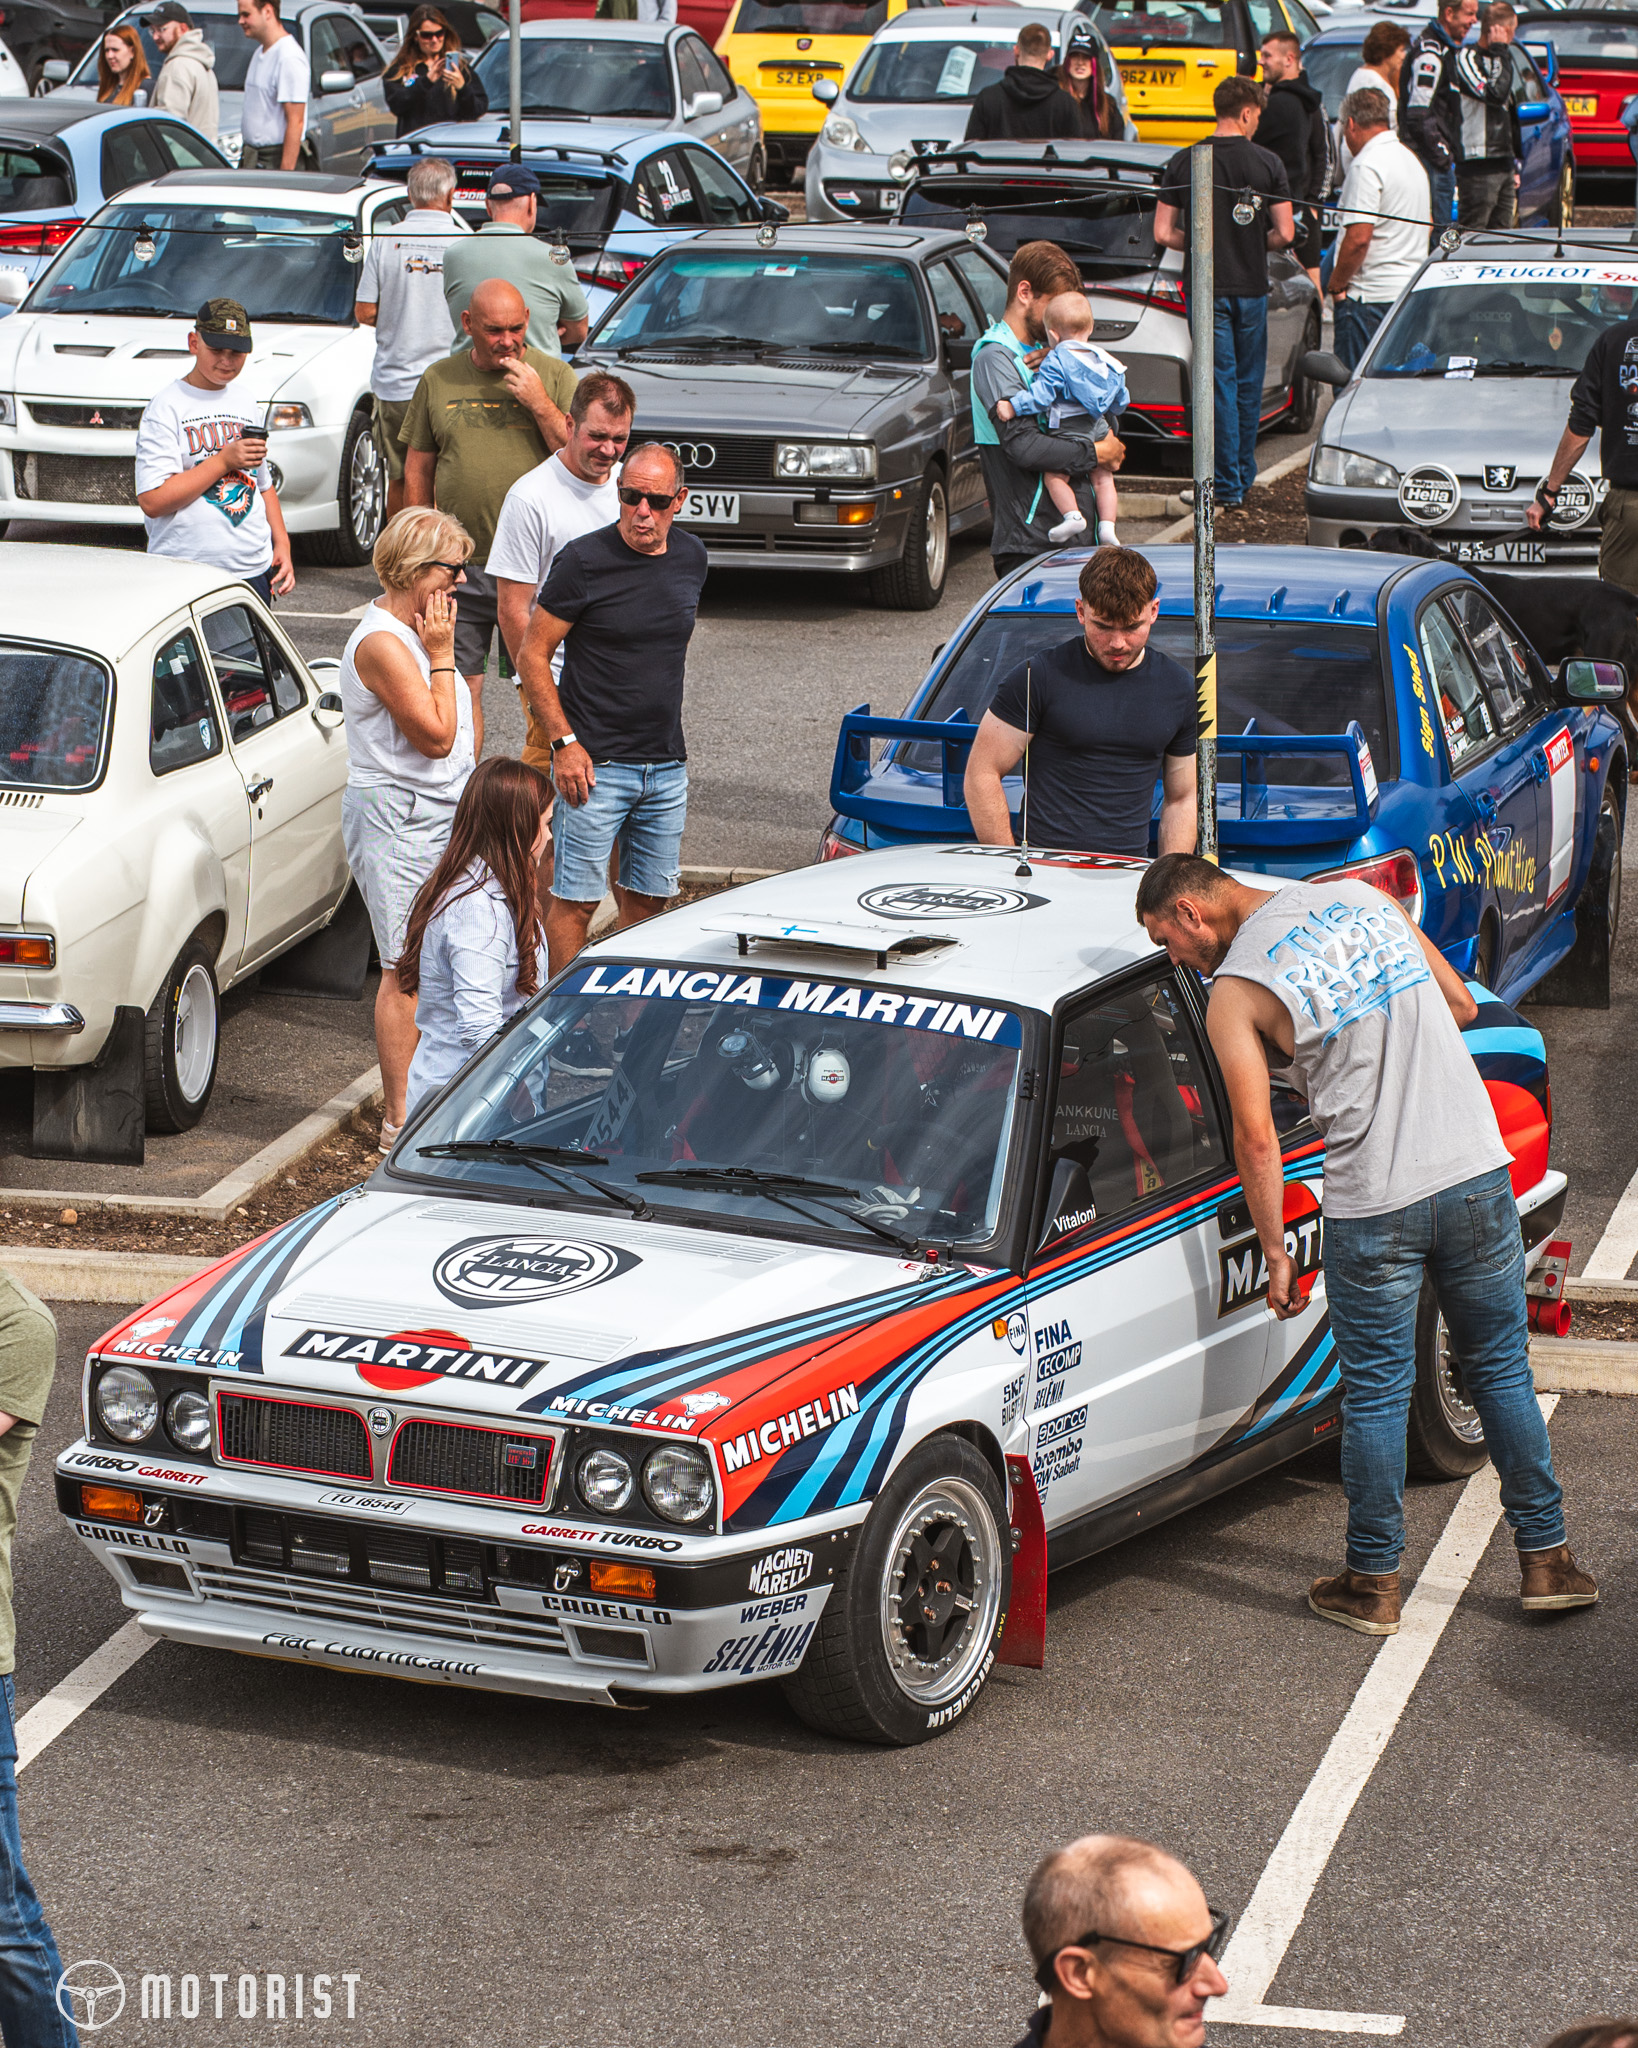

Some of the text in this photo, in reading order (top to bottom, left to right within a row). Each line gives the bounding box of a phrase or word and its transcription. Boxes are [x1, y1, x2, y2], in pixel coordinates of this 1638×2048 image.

[776, 71, 795, 84] S2
[1150, 71, 1176, 84] AVY
[1475, 266, 1596, 279] PEUGEOT
[690, 494, 735, 518] SVV
[1407, 487, 1449, 503] Hella
[1556, 493, 1586, 506] ella
[1503, 543, 1546, 562] VHK
[1402, 643, 1435, 759] Sign Shed
[905, 893, 985, 908] LANCIA
[579, 966, 1008, 1041] LANCIA MARTINI
[1055, 1104, 1119, 1121] ANKKUNE
[1066, 1122, 1107, 1138] LANCIA
[1053, 1204, 1097, 1233] Vitaloni
[484, 1255, 570, 1276] LANCIA
[904, 1262, 920, 1271] E
[1009, 1322, 1026, 1341] FINA
[1034, 1319, 1073, 1353] FINA
[112, 1340, 244, 1365] MICHELIN
[296, 1333, 533, 1384] MARTINI
[1038, 1347, 1081, 1380] CECOMP
[1003, 1373, 1025, 1404] SKF
[549, 1395, 697, 1431] MICHELIN
[720, 1381, 861, 1474] MICHELIN
[1039, 1407, 1089, 1445] sparco
[65, 1453, 208, 1485] TURBO GARRETT
[1032, 1437, 1083, 1472] brembo
[1052, 1455, 1081, 1482] Sabelt
[331, 1494, 404, 1511] TO 18544
[75, 1523, 191, 1555] CARELLO
[521, 1524, 683, 1553] GARRETT TURBO
[748, 1548, 814, 1582] MAGNETI
[748, 1564, 813, 1595] MARELLI
[541, 1595, 672, 1625] CARELLO
[740, 1593, 808, 1624] WEBER
[756, 1658, 797, 1673] MOTOR OIL
[926, 1650, 995, 1729] MICHELIN
